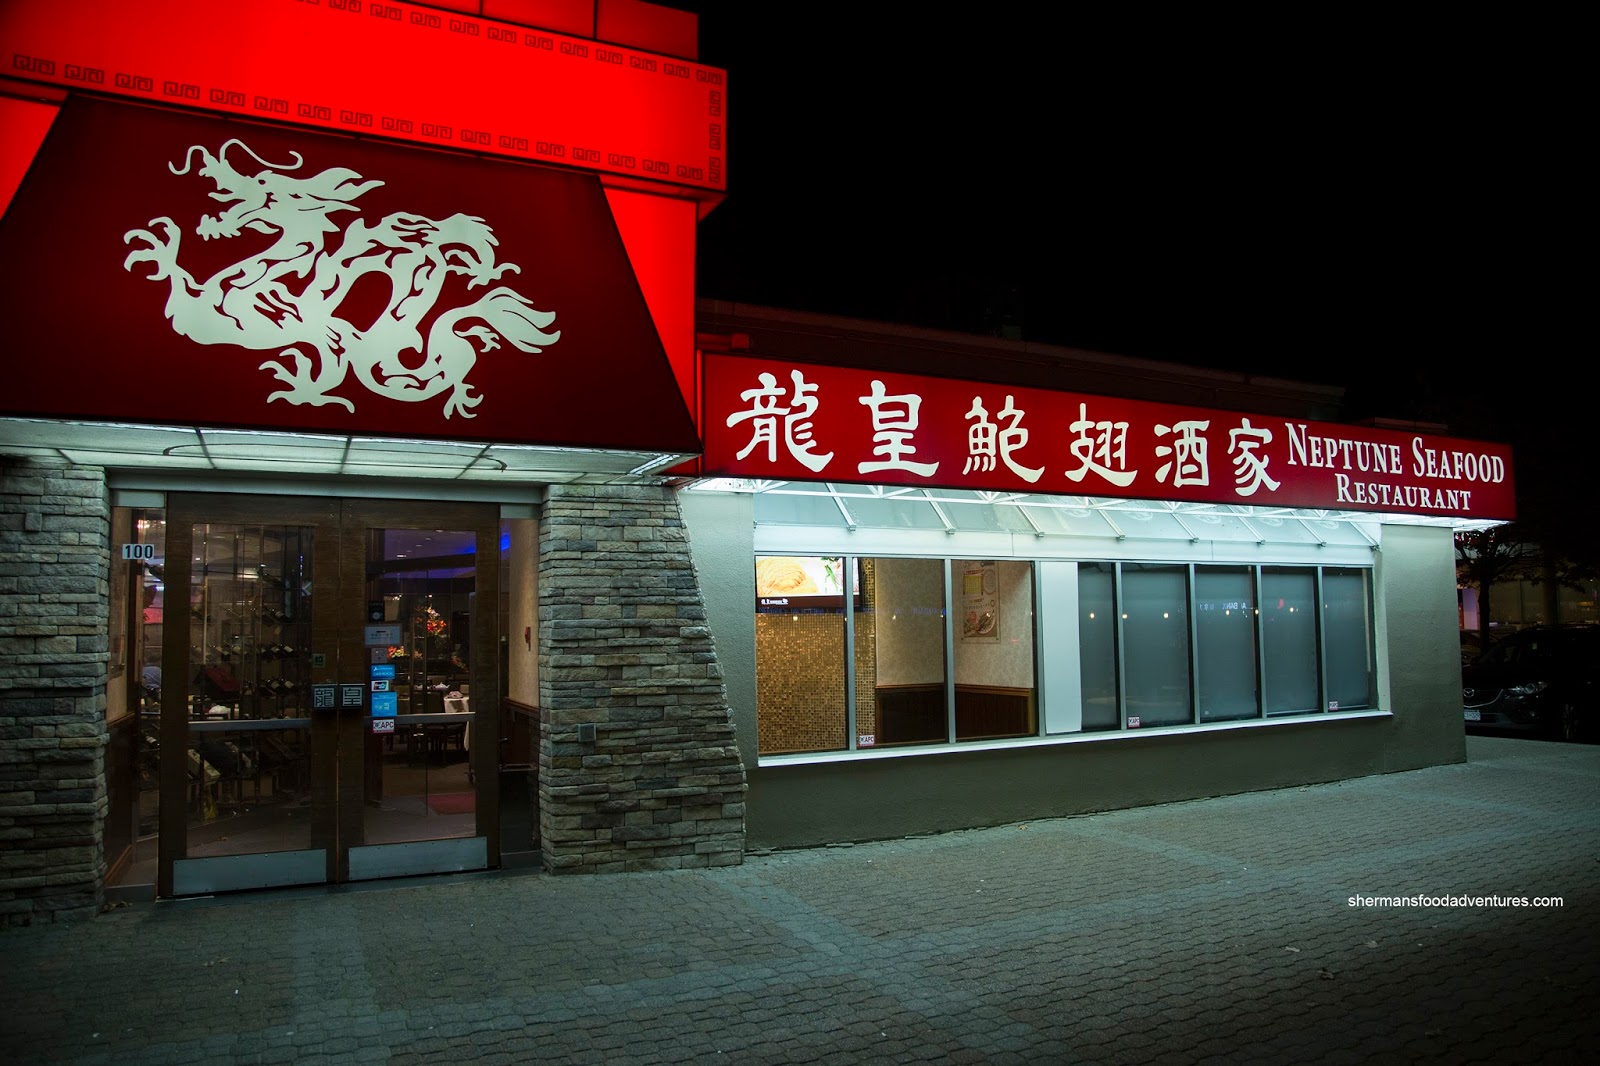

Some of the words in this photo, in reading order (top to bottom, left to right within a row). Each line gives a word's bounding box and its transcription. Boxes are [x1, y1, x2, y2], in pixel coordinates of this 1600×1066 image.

[1285, 422, 1403, 475] NEPTUNE
[1412, 436, 1505, 483] SEAFOOD
[1335, 473, 1471, 511] RESTAURANT
[125, 544, 153, 559] 100
